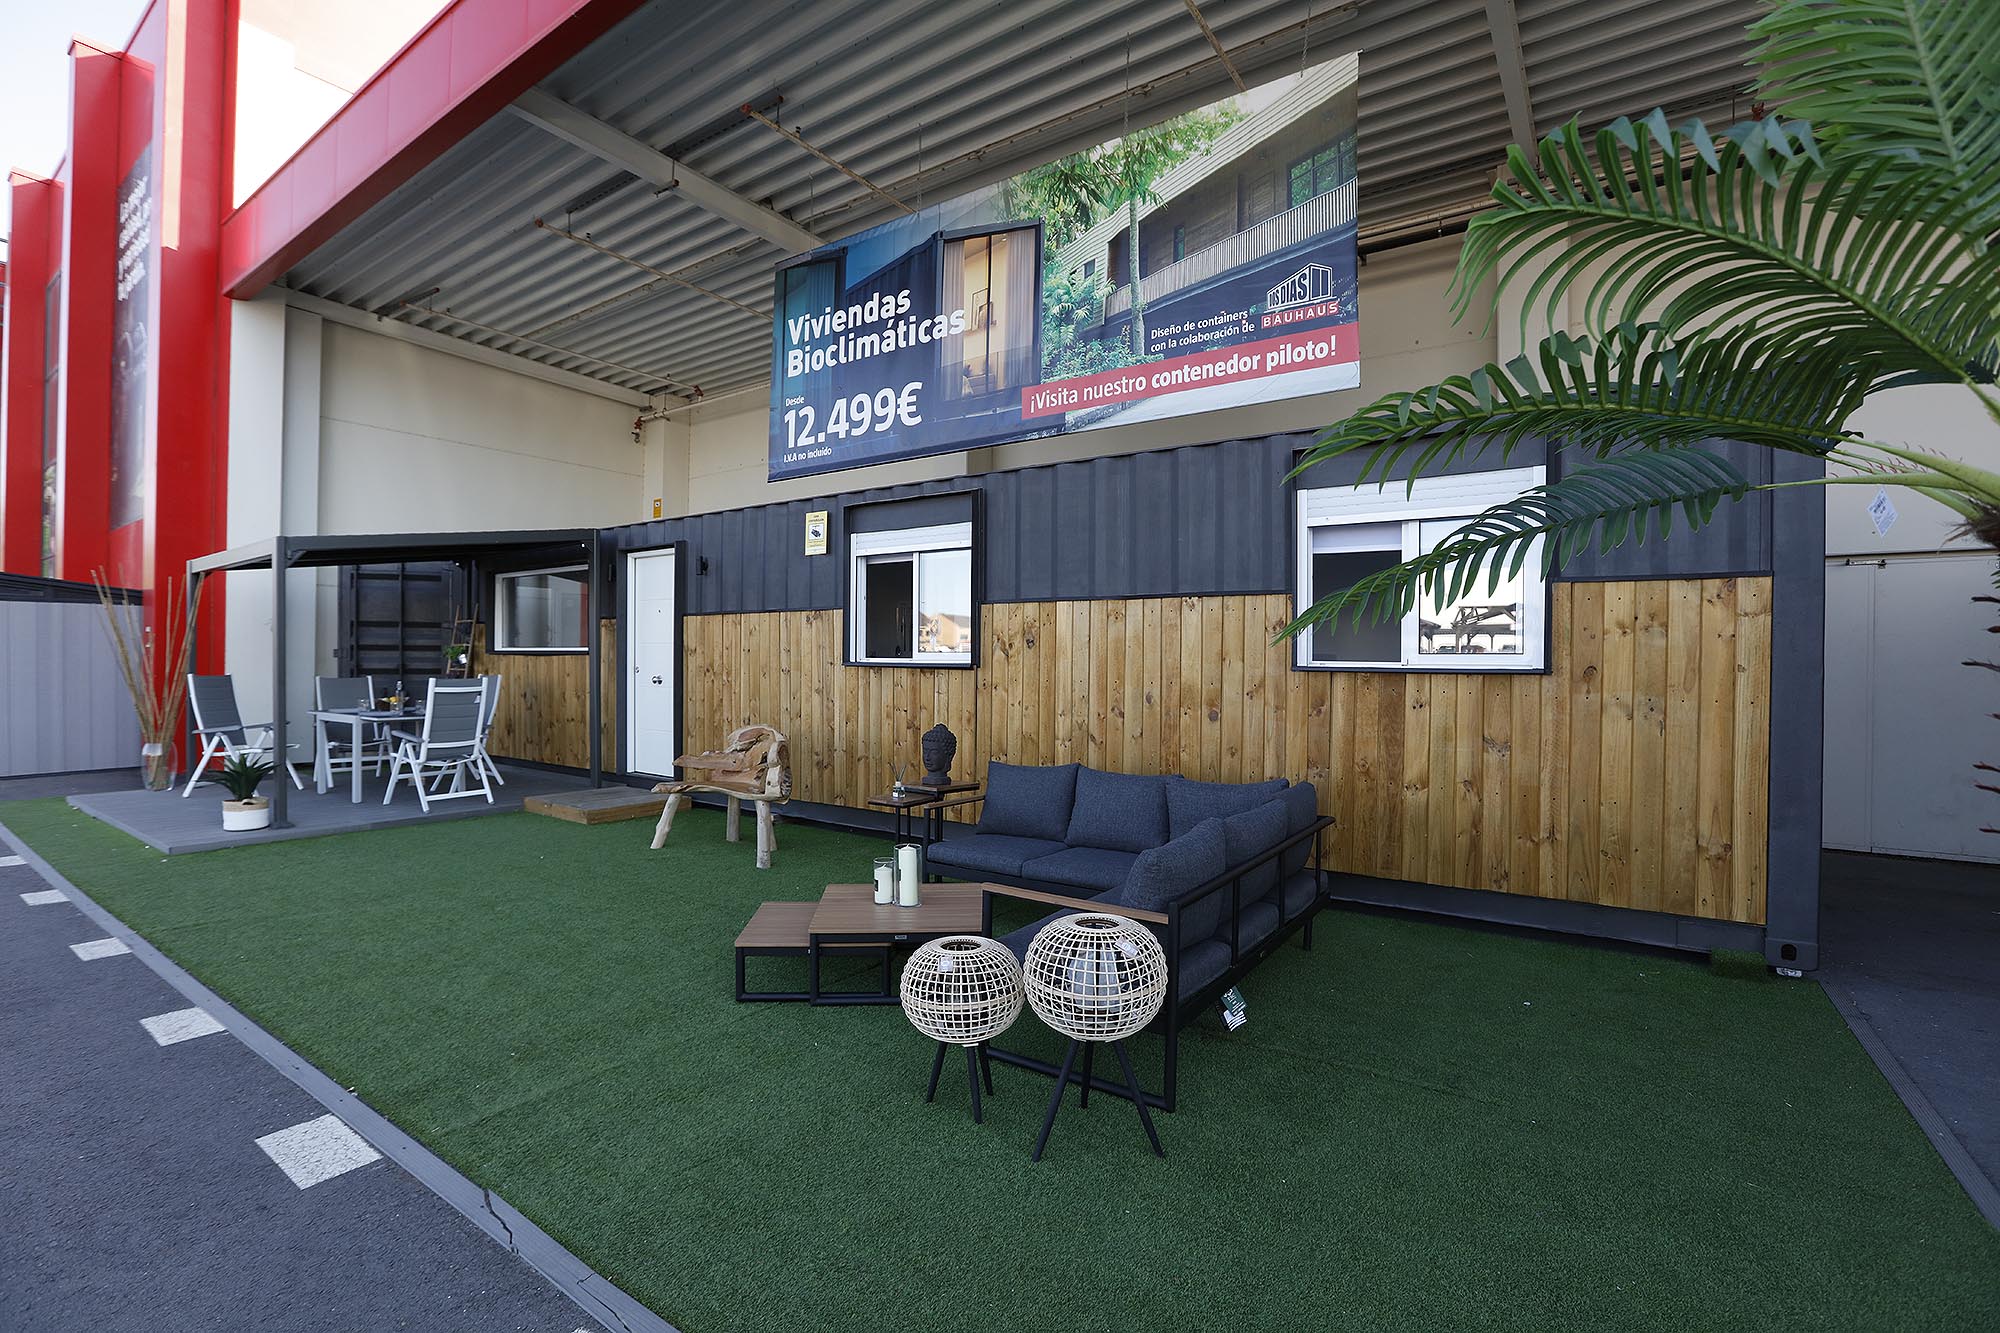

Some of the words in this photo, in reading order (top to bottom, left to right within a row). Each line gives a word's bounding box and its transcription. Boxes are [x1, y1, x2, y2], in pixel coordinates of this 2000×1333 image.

[788, 289, 911, 345] Viviendas
[1150, 324, 1182, 340] Diseño
[1183, 320, 1196, 332] de
[1197, 310, 1248, 329] containers
[1263, 300, 1339, 327] BAUHAUS
[787, 309, 966, 378] Bioclimáticas
[1150, 342, 1166, 353] con
[1168, 338, 1177, 349] la
[1179, 324, 1240, 346] colaboración
[1241, 320, 1255, 333] de
[1030, 387, 1078, 414] ¡Visita
[1083, 375, 1147, 401] nuestro
[1151, 353, 1261, 389] contenedor
[1266, 335, 1337, 373] piloto!
[784, 381, 923, 449] 12.499€
[785, 394, 805, 407] Desde
[798, 452, 807, 461] no
[807, 446, 832, 459] incluido
